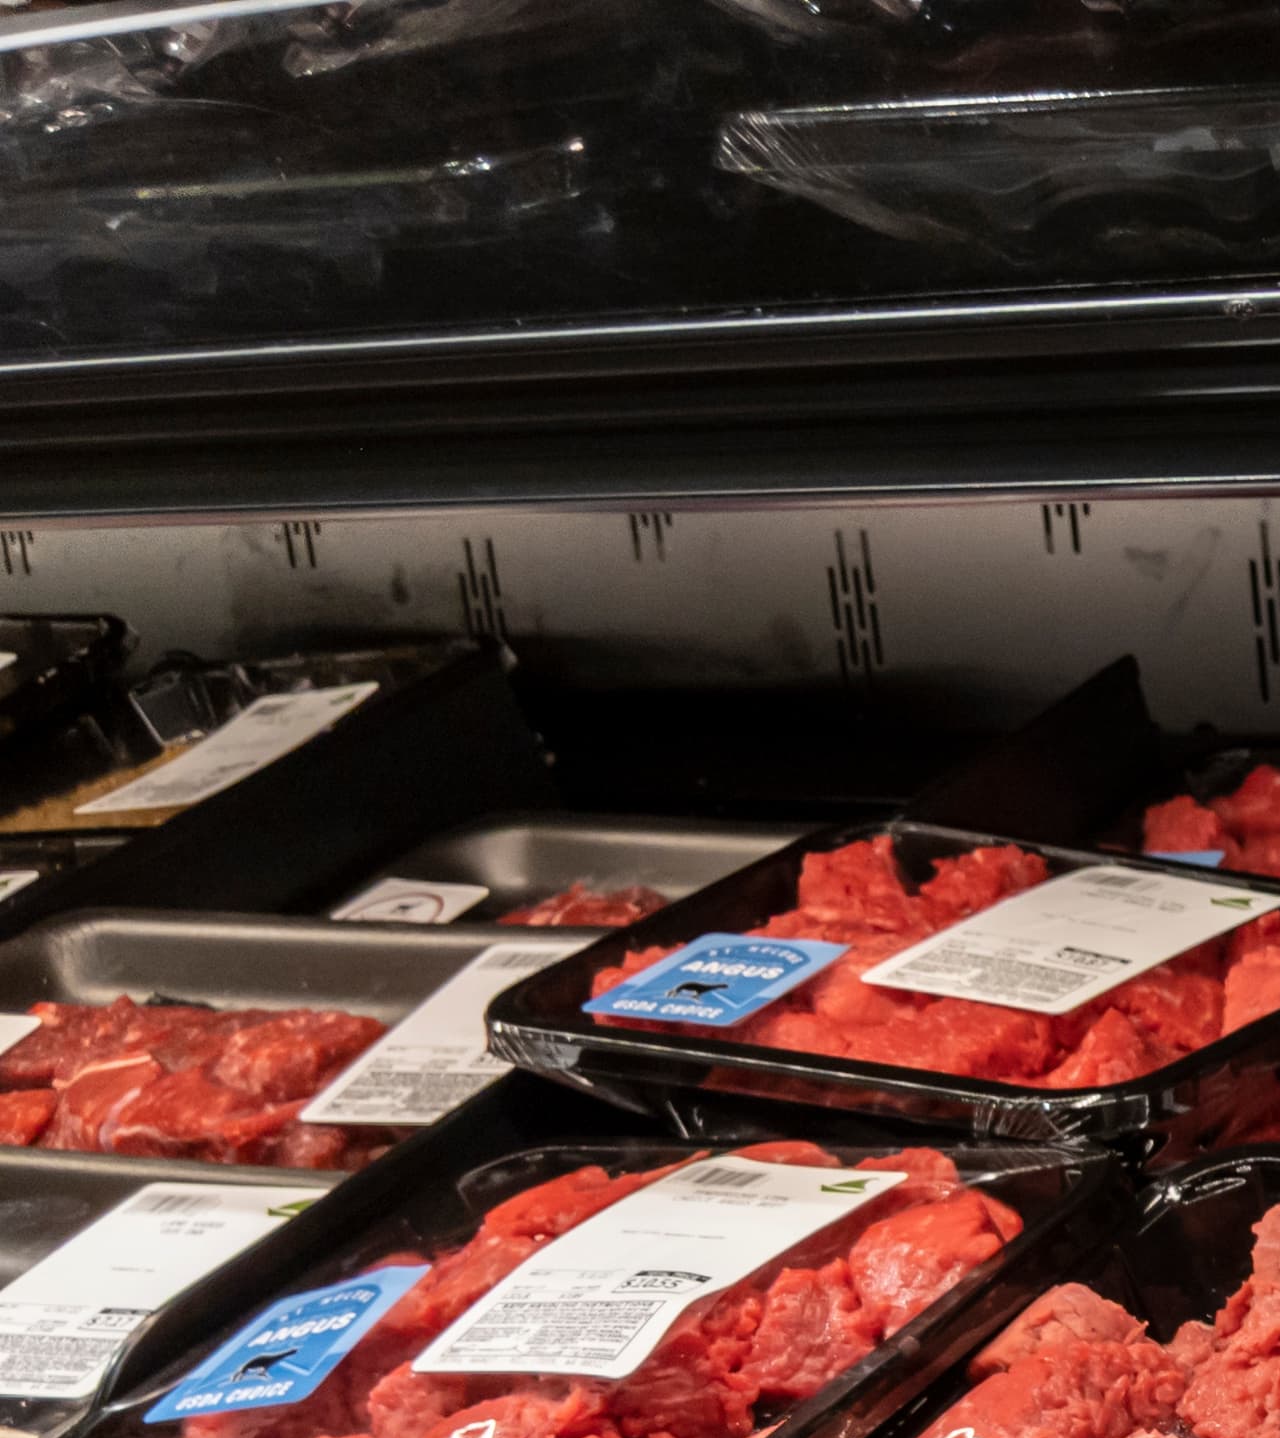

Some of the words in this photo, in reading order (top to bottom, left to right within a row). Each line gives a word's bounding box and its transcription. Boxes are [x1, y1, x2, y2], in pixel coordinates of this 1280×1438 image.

[680, 960, 785, 979] ANGUS
[248, 1312, 356, 1348] ANGUS
[175, 1392, 224, 1411] USDA
[226, 1381, 294, 1405] CHOICE
